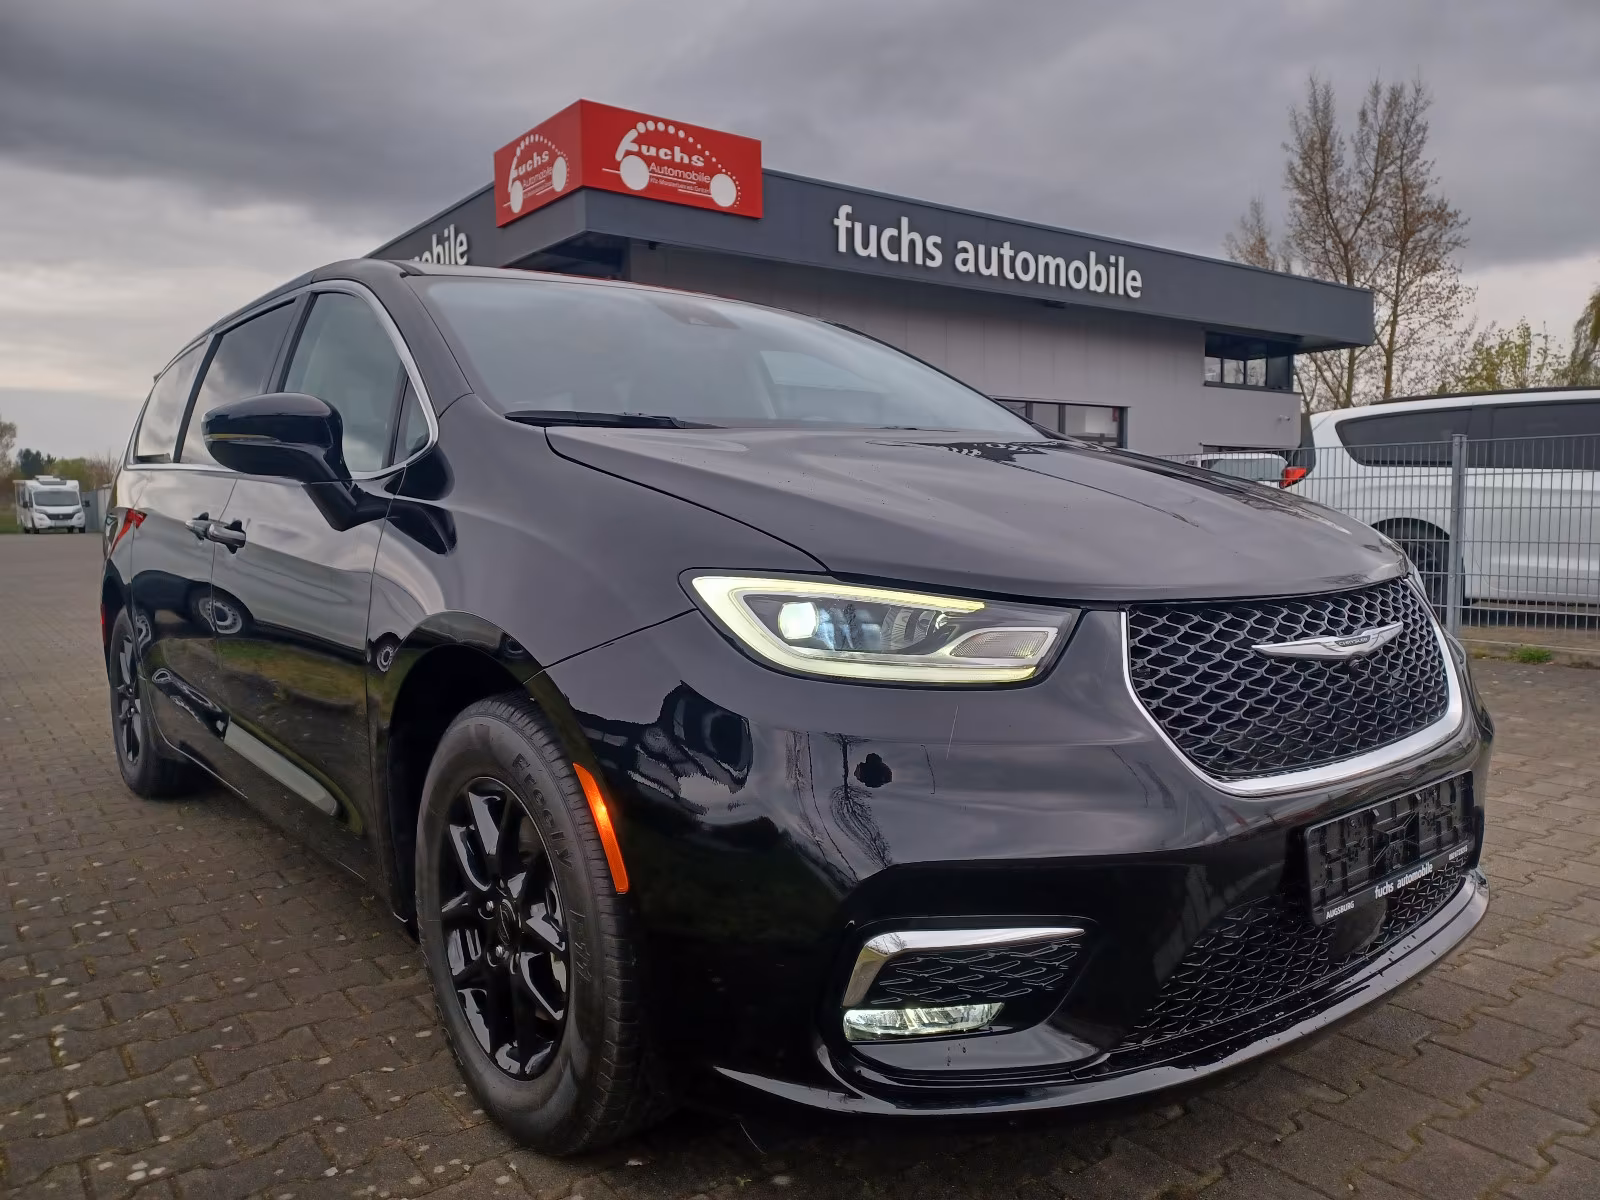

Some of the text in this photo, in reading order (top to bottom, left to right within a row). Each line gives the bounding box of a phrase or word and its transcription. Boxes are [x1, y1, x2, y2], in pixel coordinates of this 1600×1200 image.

[649, 162, 711, 183] Automobile
[833, 204, 1143, 298] fuchs automobile
[1374, 861, 1434, 900] fuchs automobile
[1326, 900, 1355, 920] AUGSBURG
